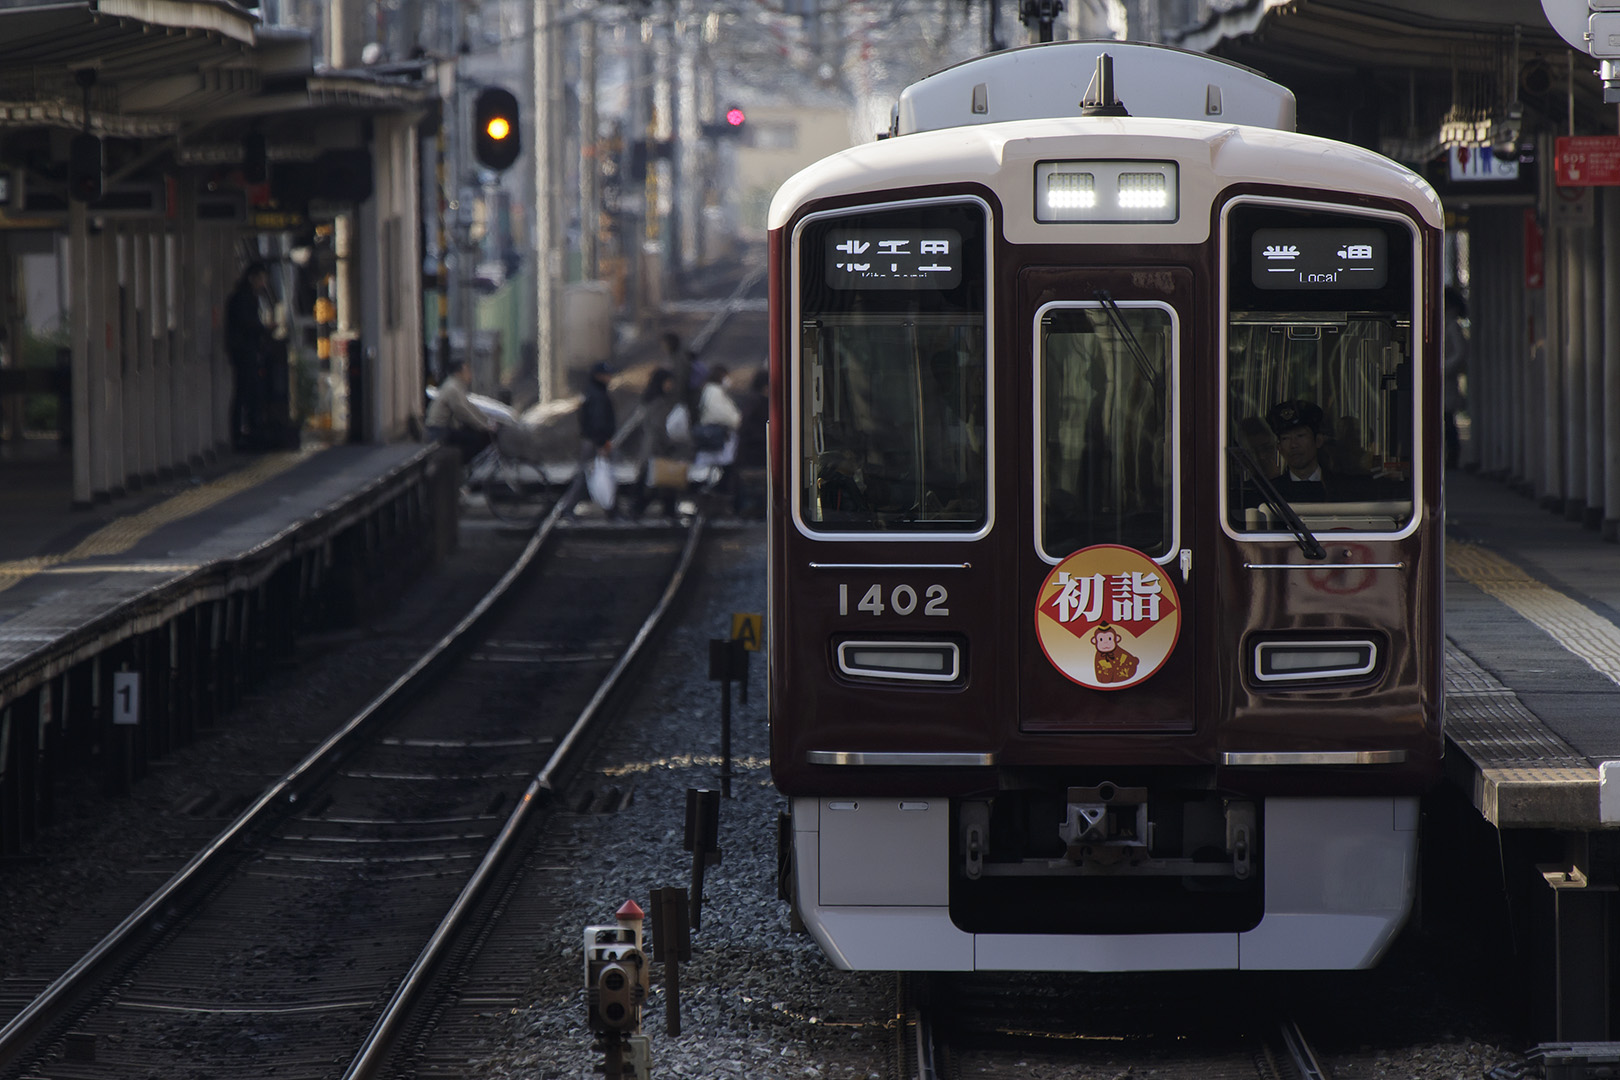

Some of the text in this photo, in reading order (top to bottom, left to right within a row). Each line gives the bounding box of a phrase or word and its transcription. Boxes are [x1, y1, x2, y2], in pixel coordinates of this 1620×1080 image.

[1562, 153, 1586, 163] SOS
[1299, 272, 1337, 283] Local
[839, 583, 949, 616] 1402
[1051, 571, 1162, 623] 初詣
[737, 617, 757, 649] A
[116, 684, 131, 715] 1
